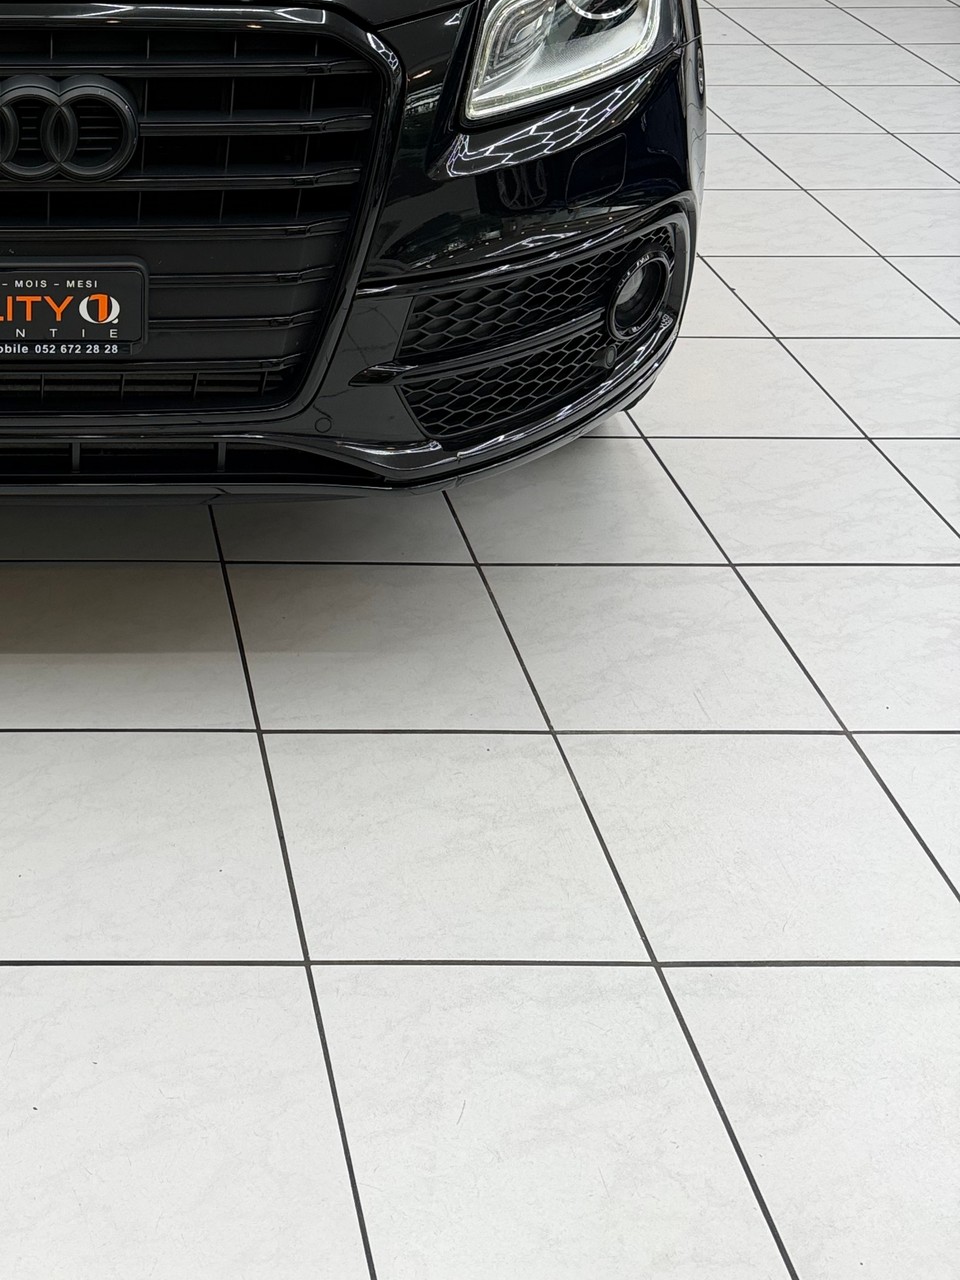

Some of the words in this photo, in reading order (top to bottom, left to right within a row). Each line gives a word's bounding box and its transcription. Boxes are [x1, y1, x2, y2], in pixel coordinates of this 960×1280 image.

[14, 280, 48, 288] MOIS
[66, 280, 98, 288] MESI
[34, 344, 56, 354] 052
[60, 344, 82, 354] 672
[86, 344, 100, 354] 28
[104, 344, 119, 354] 28
